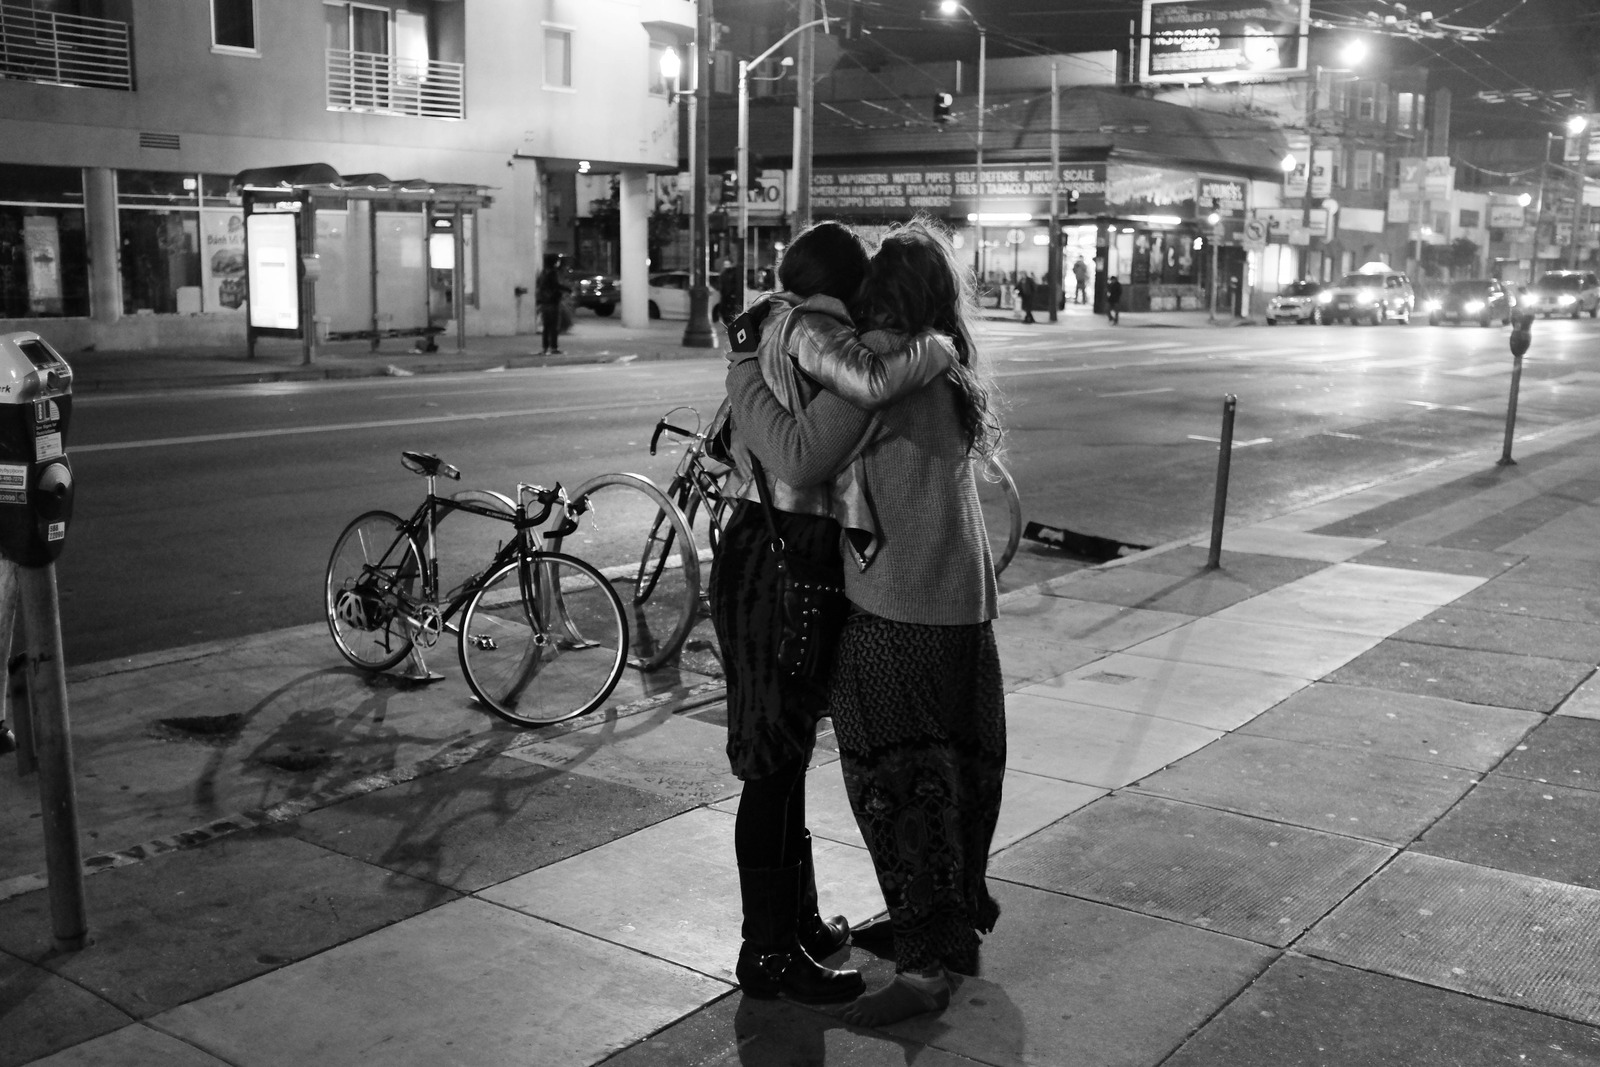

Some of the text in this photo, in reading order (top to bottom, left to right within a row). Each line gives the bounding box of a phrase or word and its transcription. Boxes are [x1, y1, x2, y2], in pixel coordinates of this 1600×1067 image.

[892, 172, 922, 183] WATER
[925, 172, 951, 183] PIPES
[955, 171, 976, 183] SELF
[1063, 169, 1095, 181] SCALE
[878, 184, 903, 195] PIPES
